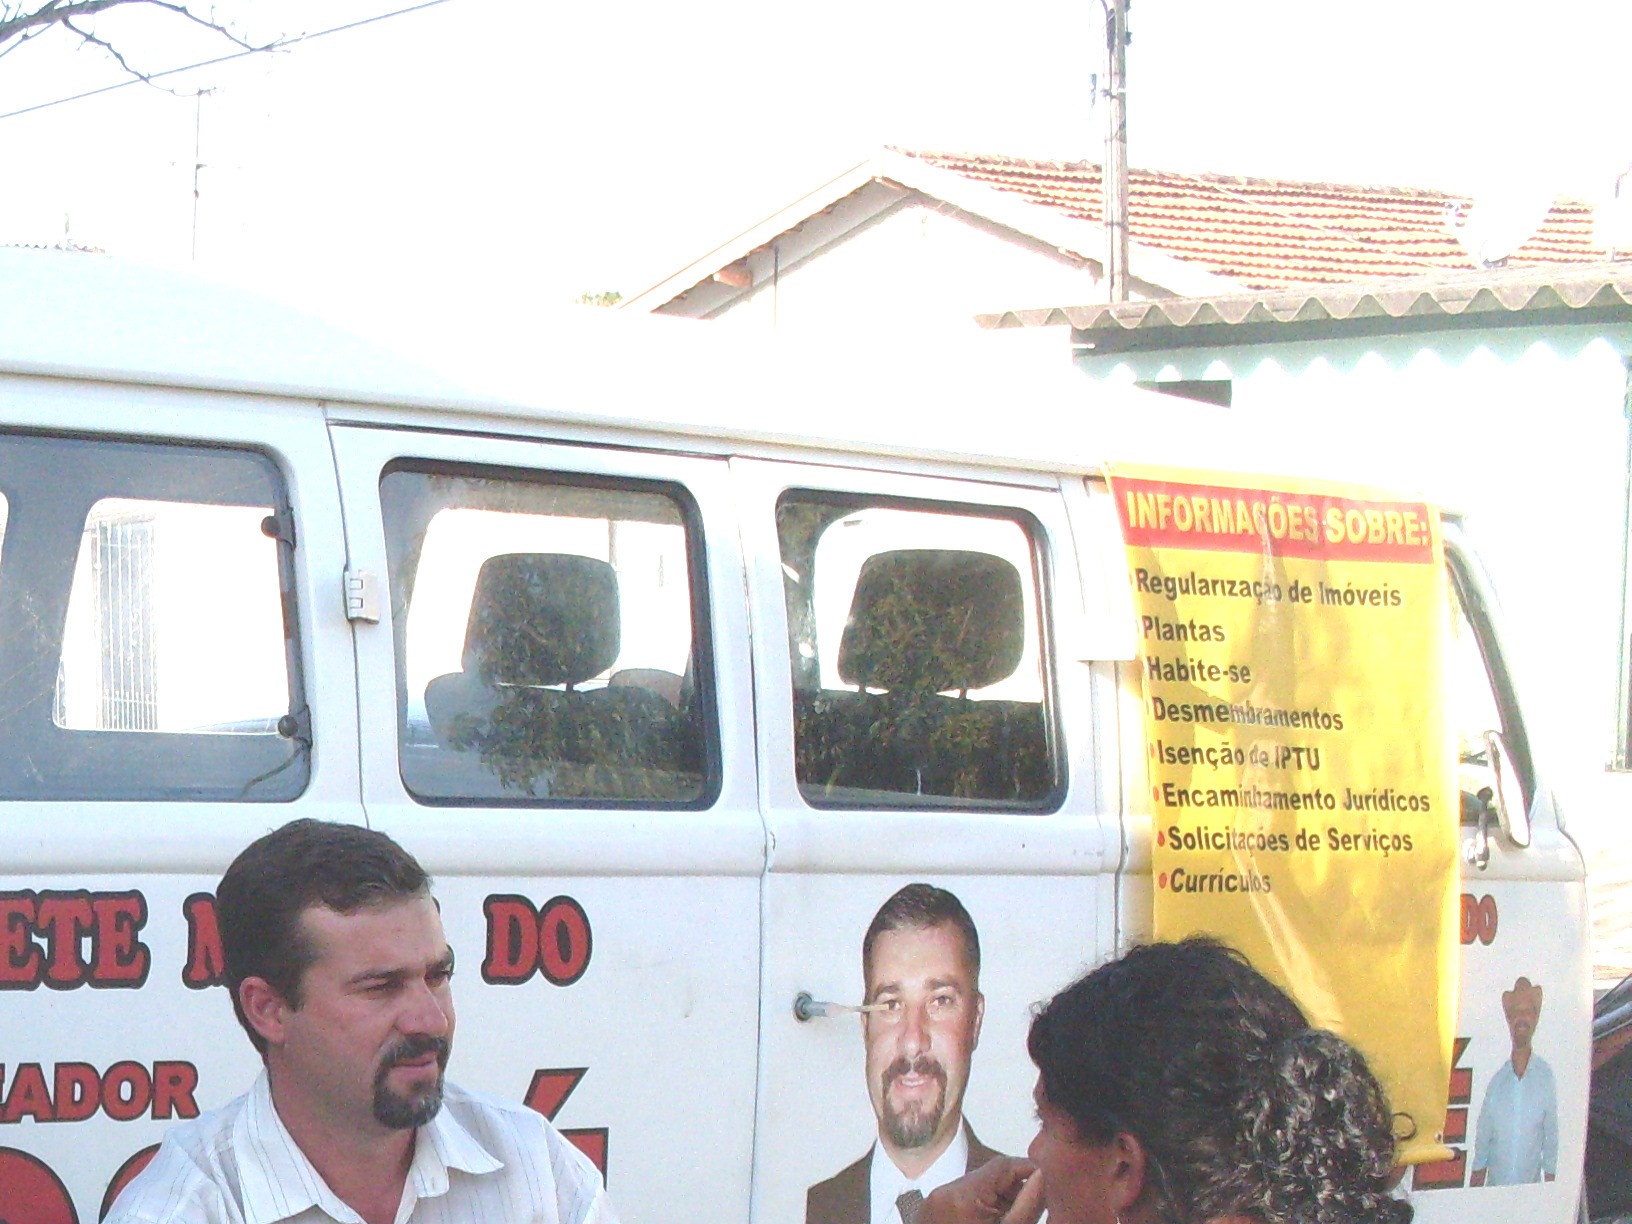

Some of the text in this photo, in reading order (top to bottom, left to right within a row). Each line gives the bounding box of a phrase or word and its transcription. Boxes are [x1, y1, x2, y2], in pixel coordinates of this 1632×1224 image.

[1127, 491, 1429, 547] INFORMAÇÕES SOBRE:
[1135, 568, 1402, 607] Regularização de Imóveis
[1142, 614, 1226, 643] Plantas
[1147, 656, 1252, 684] Habite-se
[1151, 695, 1344, 731] Desmembramentos
[1157, 740, 1321, 771] Isenção de IPTU
[1162, 782, 1431, 813] Encaminhamento Jurídicos
[1167, 826, 1413, 857] Solicitações de Serviços
[1170, 867, 1271, 893] Currículos
[481, 893, 594, 988] DO
